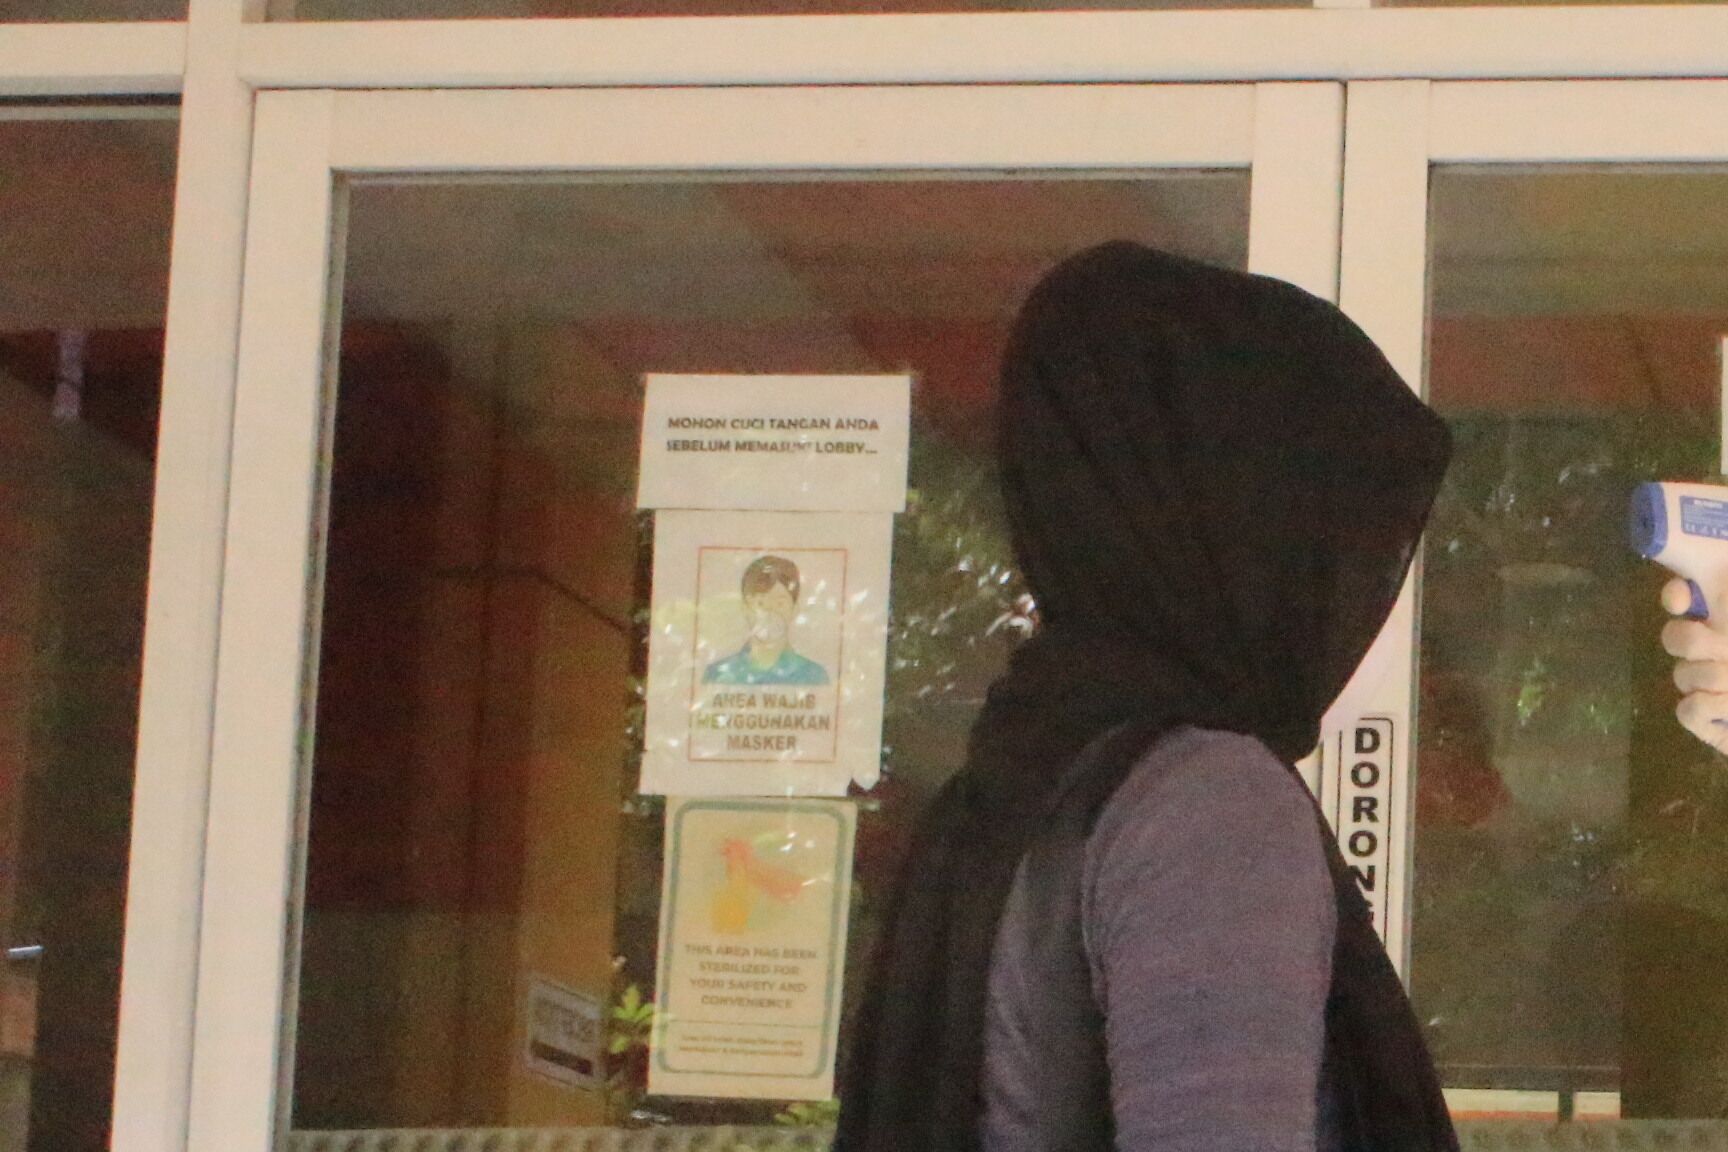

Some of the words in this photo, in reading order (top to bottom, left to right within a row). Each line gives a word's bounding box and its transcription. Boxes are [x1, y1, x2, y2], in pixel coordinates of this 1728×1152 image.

[667, 417, 727, 430] MOHON
[730, 417, 765, 430] CUCI
[768, 418, 831, 431] TANGAN
[834, 418, 880, 431] ANDA
[666, 439, 731, 452] SEBELUM
[711, 692, 757, 709] AREA
[726, 734, 797, 751] MASKER
[1348, 727, 1381, 922] DORON
